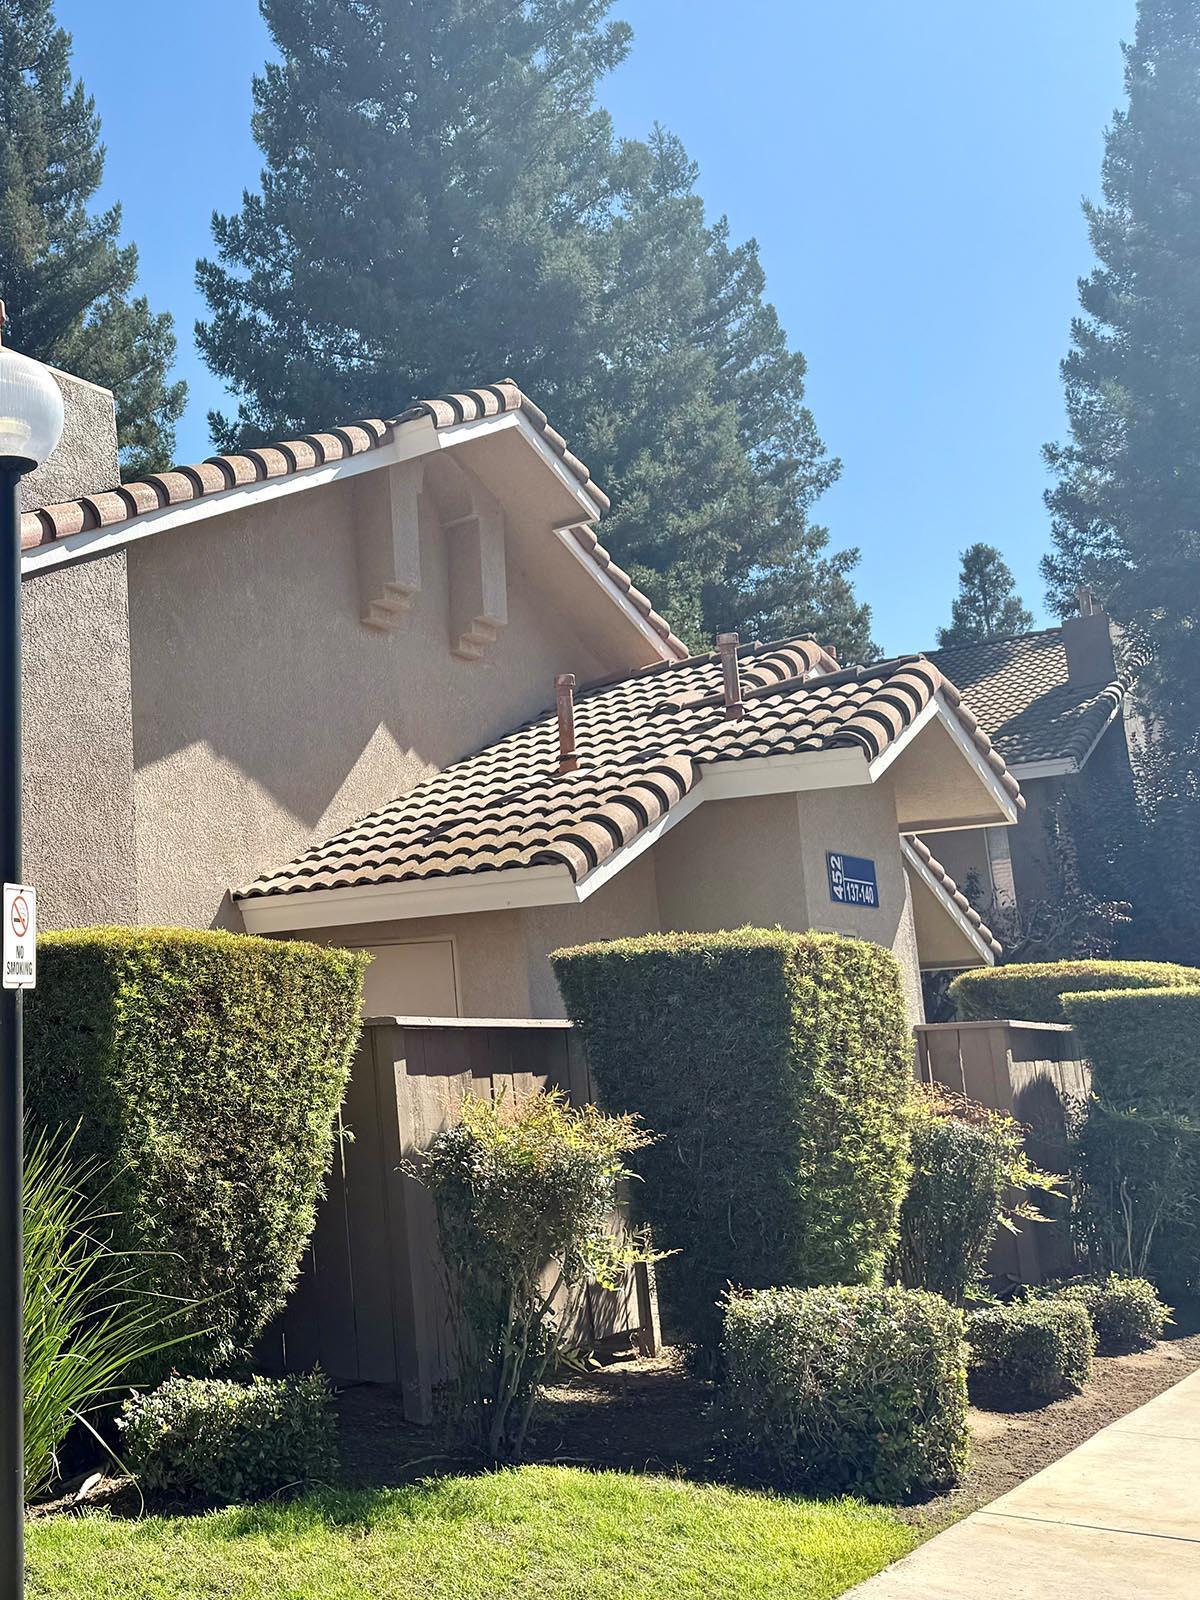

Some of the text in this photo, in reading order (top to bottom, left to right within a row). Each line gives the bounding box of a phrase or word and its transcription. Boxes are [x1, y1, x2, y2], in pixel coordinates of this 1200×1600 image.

[830, 855, 843, 900] 452
[846, 882, 874, 904] 137-140
[16, 945, 24, 959] NO
[6, 961, 32, 975] SMOKING
